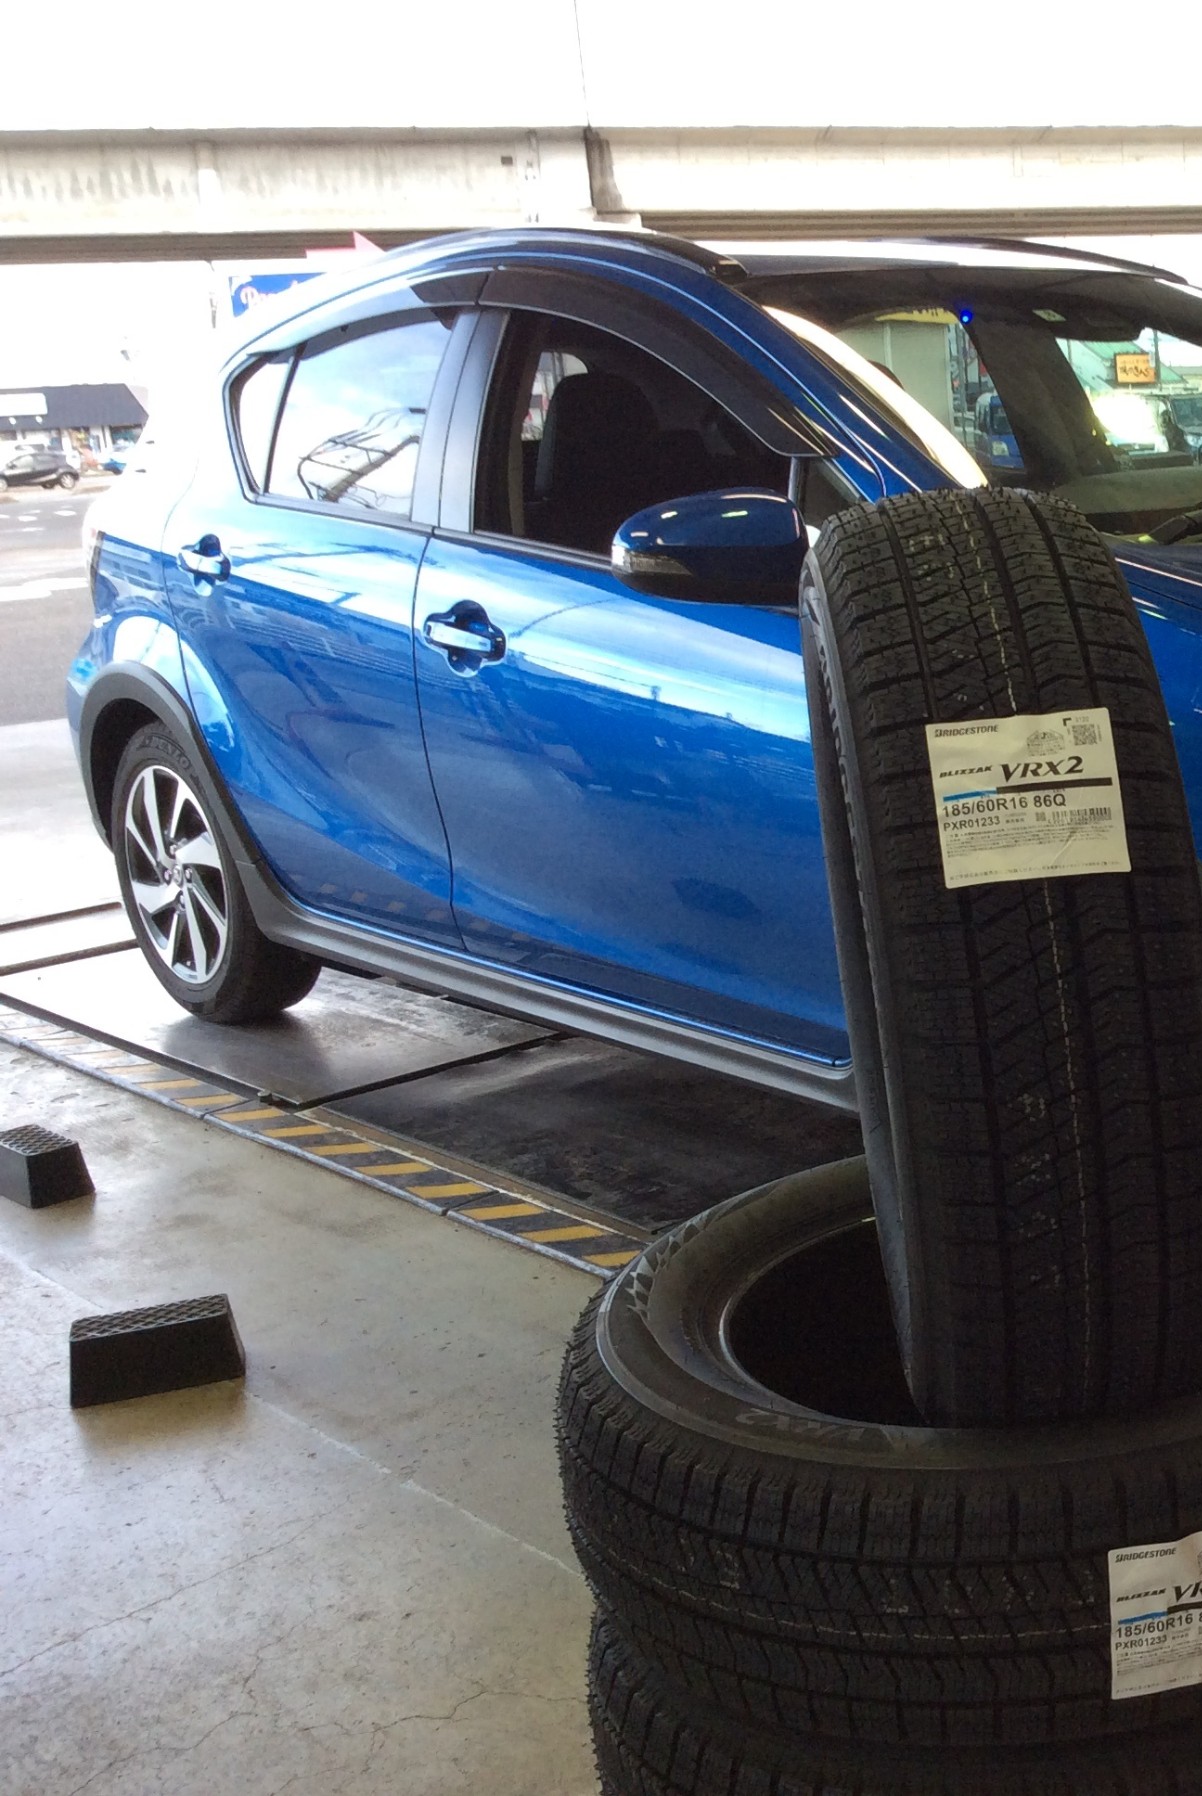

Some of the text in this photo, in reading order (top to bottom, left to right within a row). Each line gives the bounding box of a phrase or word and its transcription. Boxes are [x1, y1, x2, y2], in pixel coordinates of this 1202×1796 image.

[934, 724, 999, 738] BRIDGESTONE
[939, 756, 1084, 783] BLIZZAK VRX2
[942, 793, 1067, 818] 185/60R16 86Q
[943, 815, 1001, 832] PXR01233
[1115, 1547, 1177, 1563] BRIDGESTONE
[1115, 1614, 1194, 1639] 185/60R16
[1115, 1635, 1168, 1651] PXR01233
